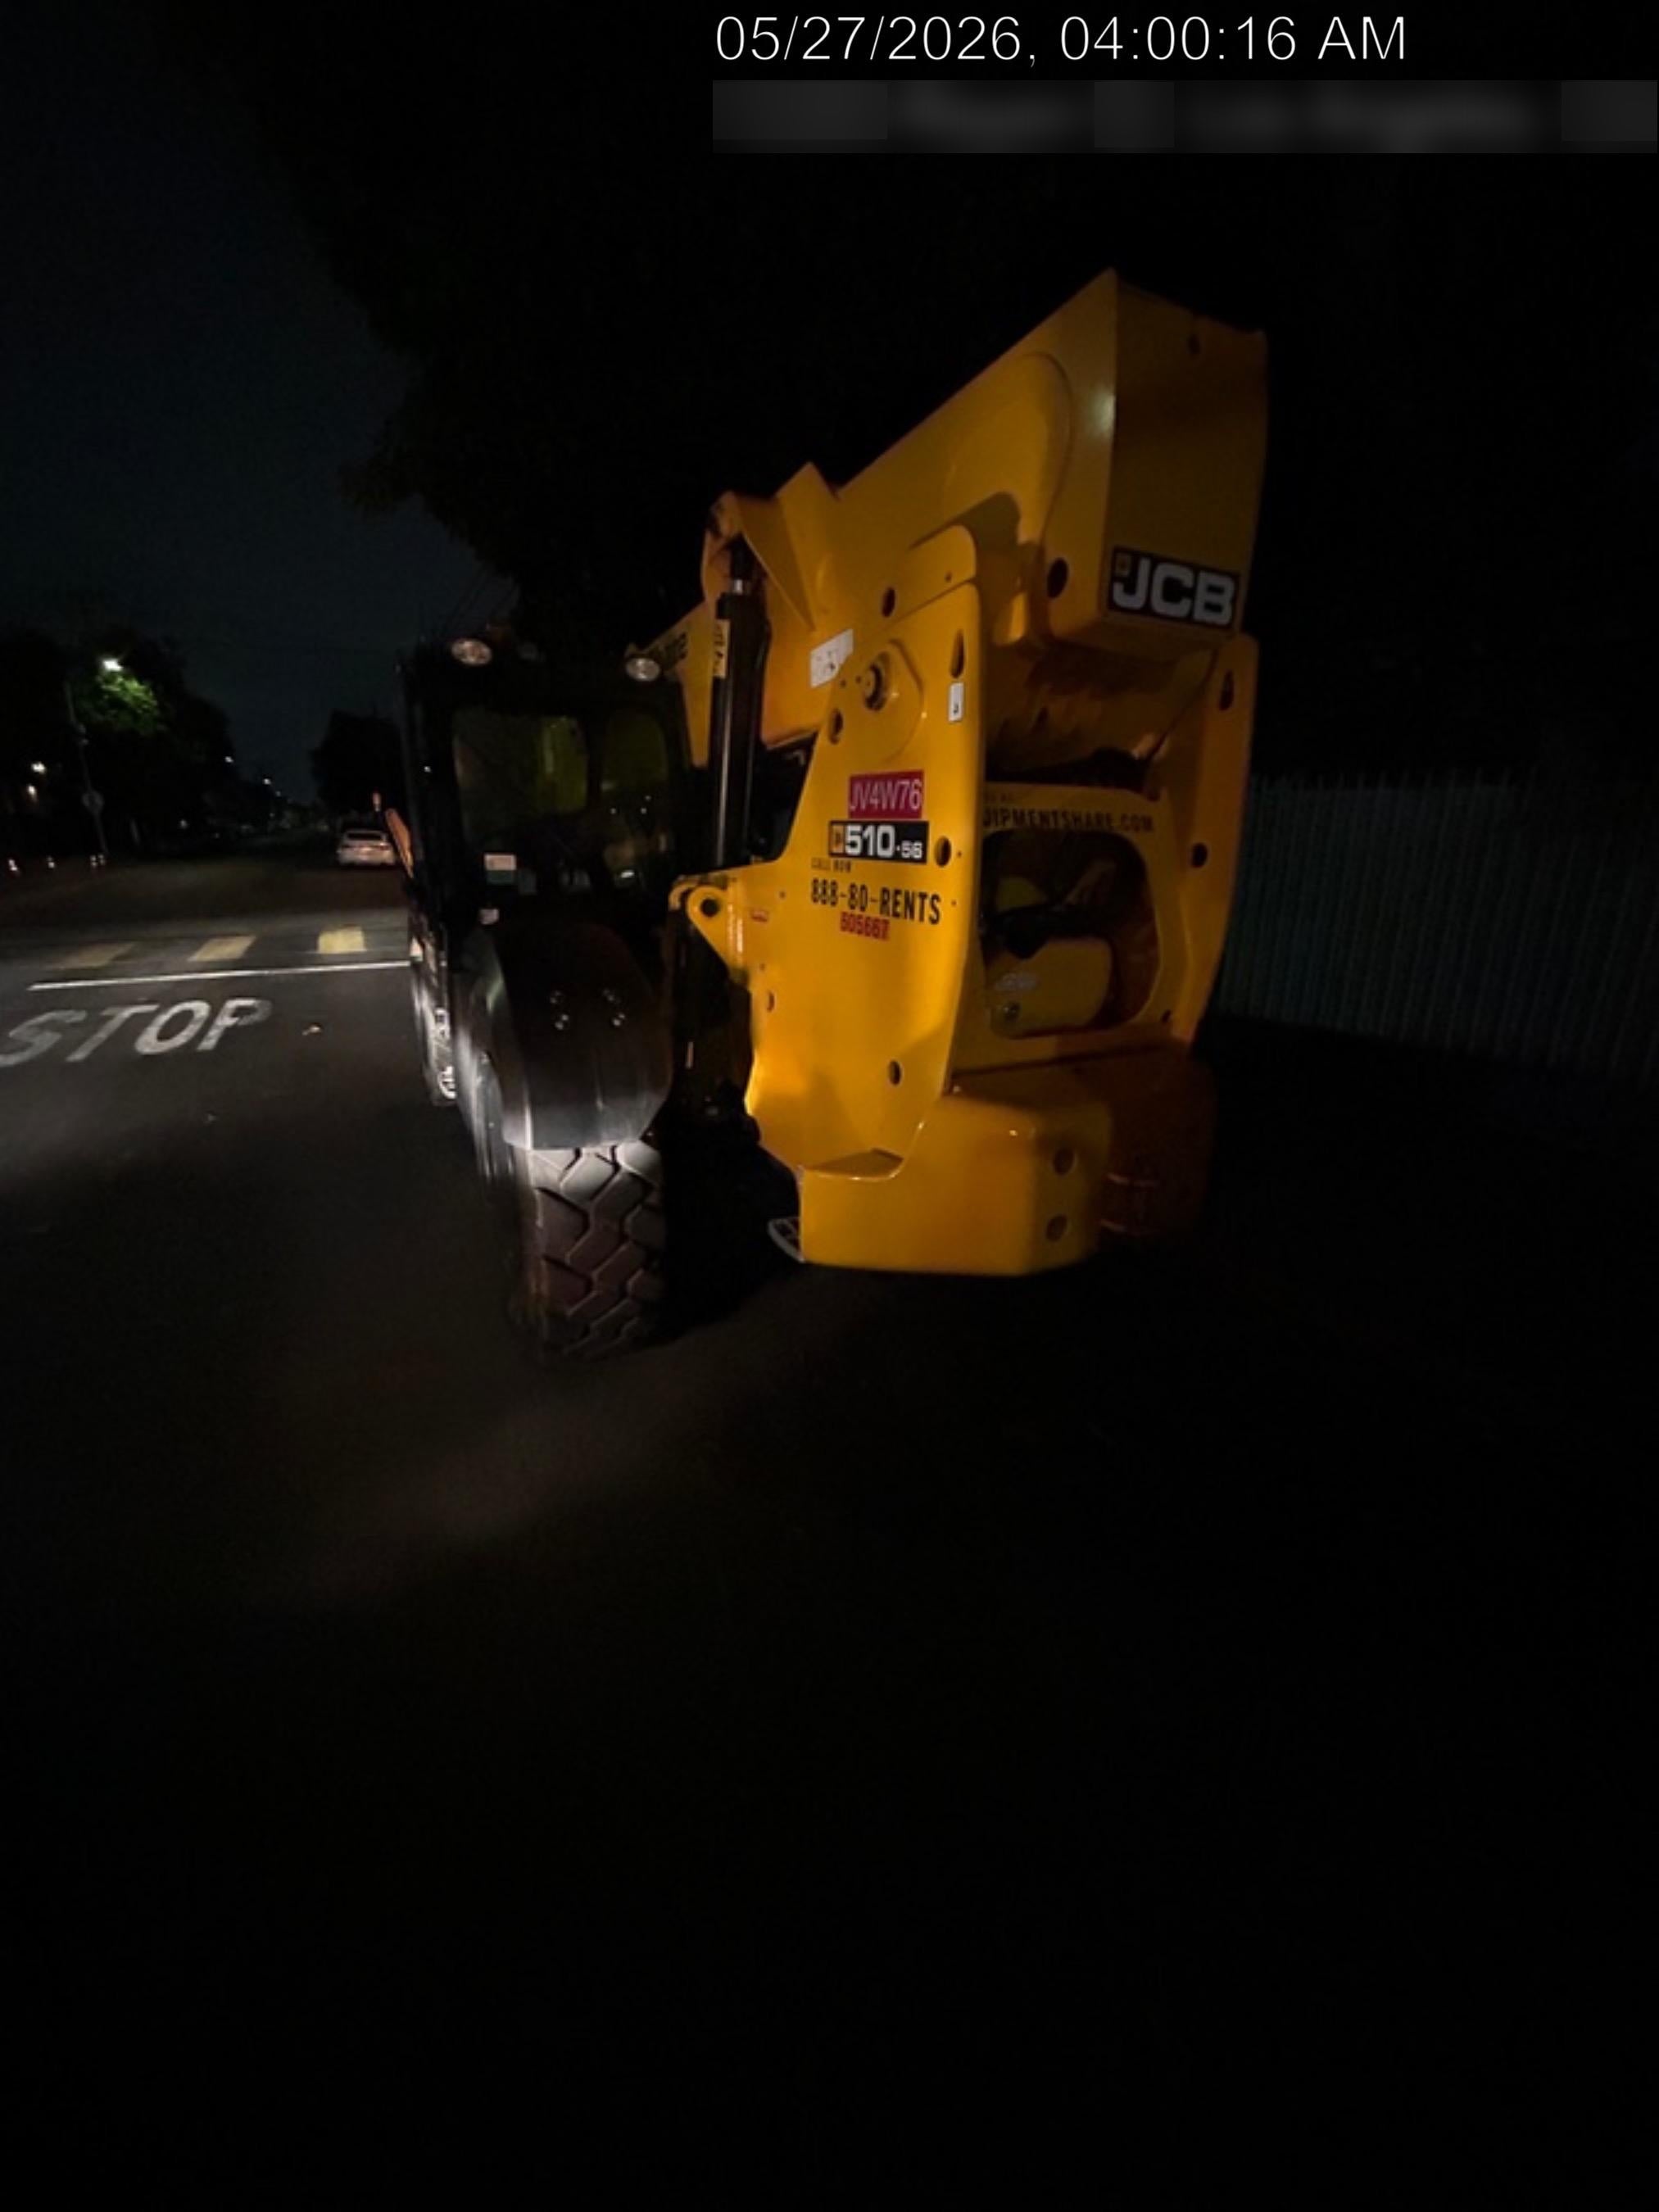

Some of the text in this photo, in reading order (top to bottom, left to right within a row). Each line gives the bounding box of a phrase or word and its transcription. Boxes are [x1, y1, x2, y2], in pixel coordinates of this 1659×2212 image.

[1113, 557, 1235, 626] JCB
[850, 778, 922, 810] JV4W76
[811, 877, 941, 925] 888-80-RENTS
[0, 997, 272, 1066] STOP
